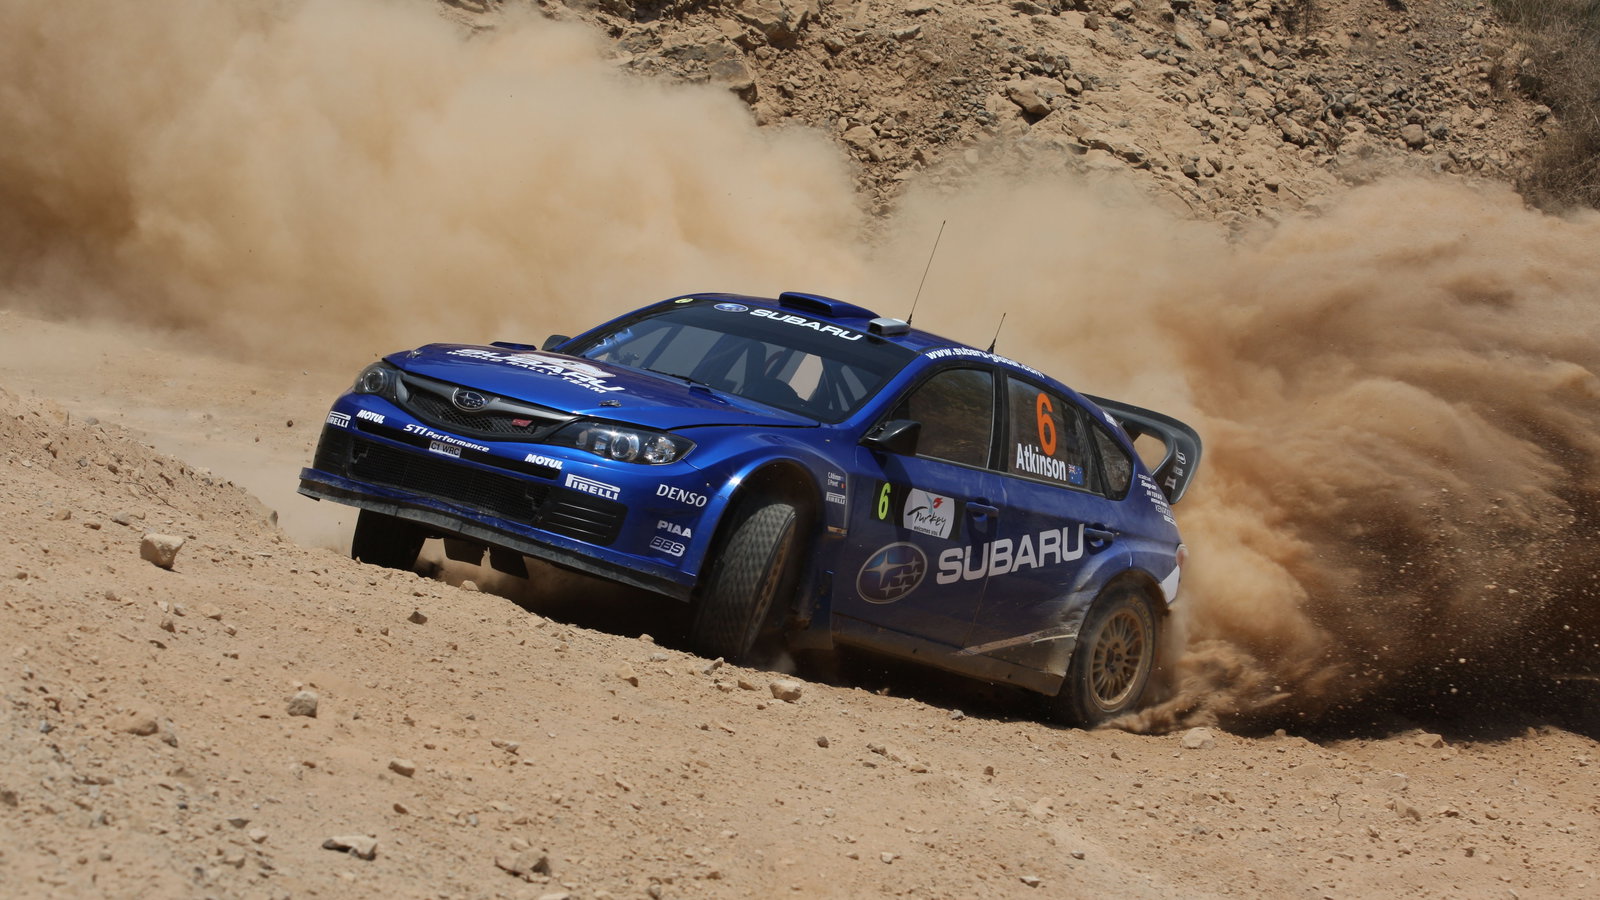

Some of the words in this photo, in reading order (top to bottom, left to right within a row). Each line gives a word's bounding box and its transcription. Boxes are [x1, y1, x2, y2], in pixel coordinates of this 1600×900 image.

[749, 309, 863, 341] SUBARU
[562, 376, 607, 394] TEAM
[356, 409, 385, 424] MOTUL
[1036, 392, 1057, 457] 6
[403, 423, 428, 436] STI
[427, 431, 490, 453] Performance
[443, 446, 460, 456] WRC
[525, 453, 563, 470] MOTUL
[1016, 442, 1067, 481] Atkinson
[565, 473, 620, 501] PIRELLI
[656, 483, 707, 508] DENSO
[878, 482, 891, 520] 6
[657, 520, 692, 539] PIAA
[906, 506, 946, 536] Turkey
[650, 536, 686, 557] BBS
[936, 523, 1085, 585] SUBARU
